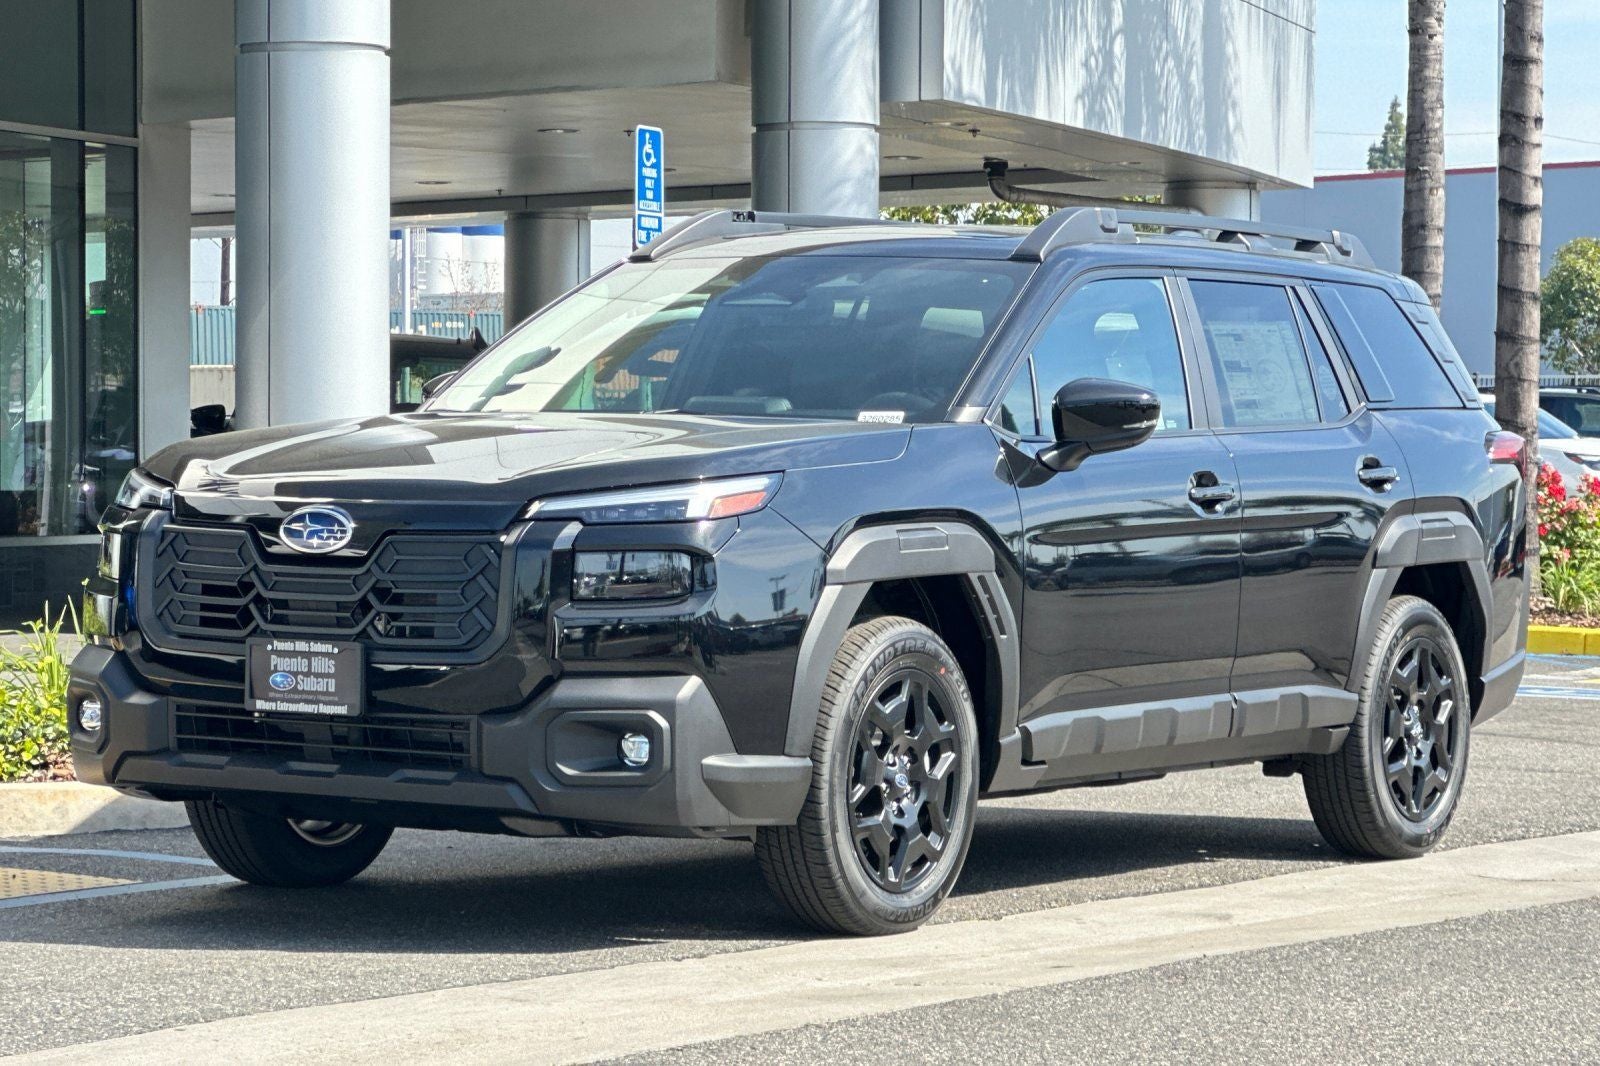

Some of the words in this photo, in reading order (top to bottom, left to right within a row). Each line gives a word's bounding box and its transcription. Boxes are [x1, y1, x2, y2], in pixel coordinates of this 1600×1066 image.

[642, 167, 657, 178] PARKING
[645, 178, 655, 189] ONLY
[646, 189, 654, 200] VAN
[639, 200, 660, 211] ACCESSIBLE
[641, 216, 659, 229] MINIMUM
[638, 229, 647, 242] FINE
[273, 640, 294, 652] Puente
[295, 641, 309, 653] Hills
[310, 641, 333, 653] Subaru
[270, 654, 308, 672] Puente
[311, 656, 336, 674] Hills
[297, 674, 336, 692] Subaru
[255, 699, 276, 711] Where
[277, 700, 318, 714] Extraordinary
[318, 703, 348, 715] Happens!
